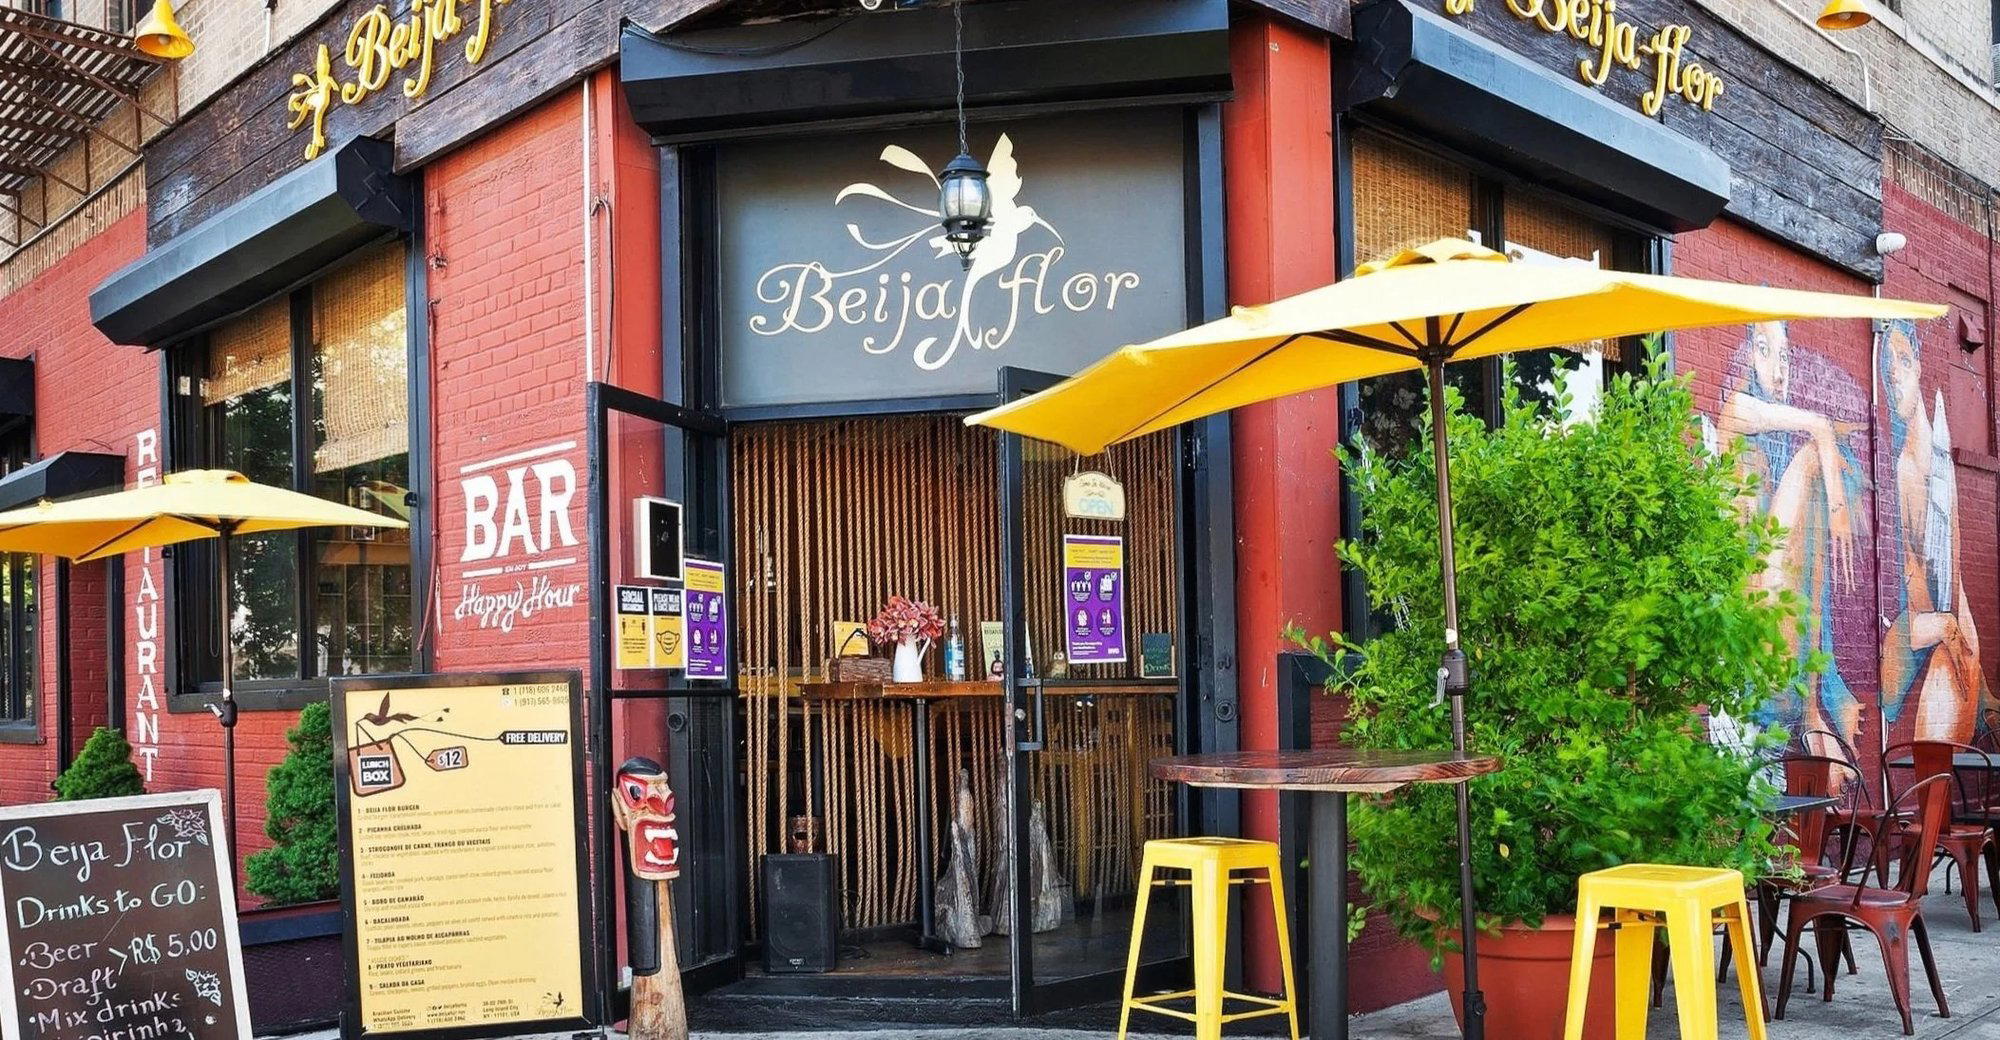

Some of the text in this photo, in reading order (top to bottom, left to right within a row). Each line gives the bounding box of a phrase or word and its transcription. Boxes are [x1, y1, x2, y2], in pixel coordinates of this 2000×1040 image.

[749, 243, 1140, 355] Beija flor
[460, 459, 580, 562] BAR
[454, 575, 580, 634] Happy Hour
[506, 732, 565, 743] FREE DELIVERY
[363, 770, 389, 782] BOX
[439, 751, 461, 766] $12
[2, 821, 191, 883] Beija Flor
[16, 879, 206, 929] Drinks to GO:
[24, 941, 98, 969] Beer
[168, 927, 217, 958] 5,00
[29, 966, 117, 1006] Draft
[38, 1008, 88, 1034] Mix
